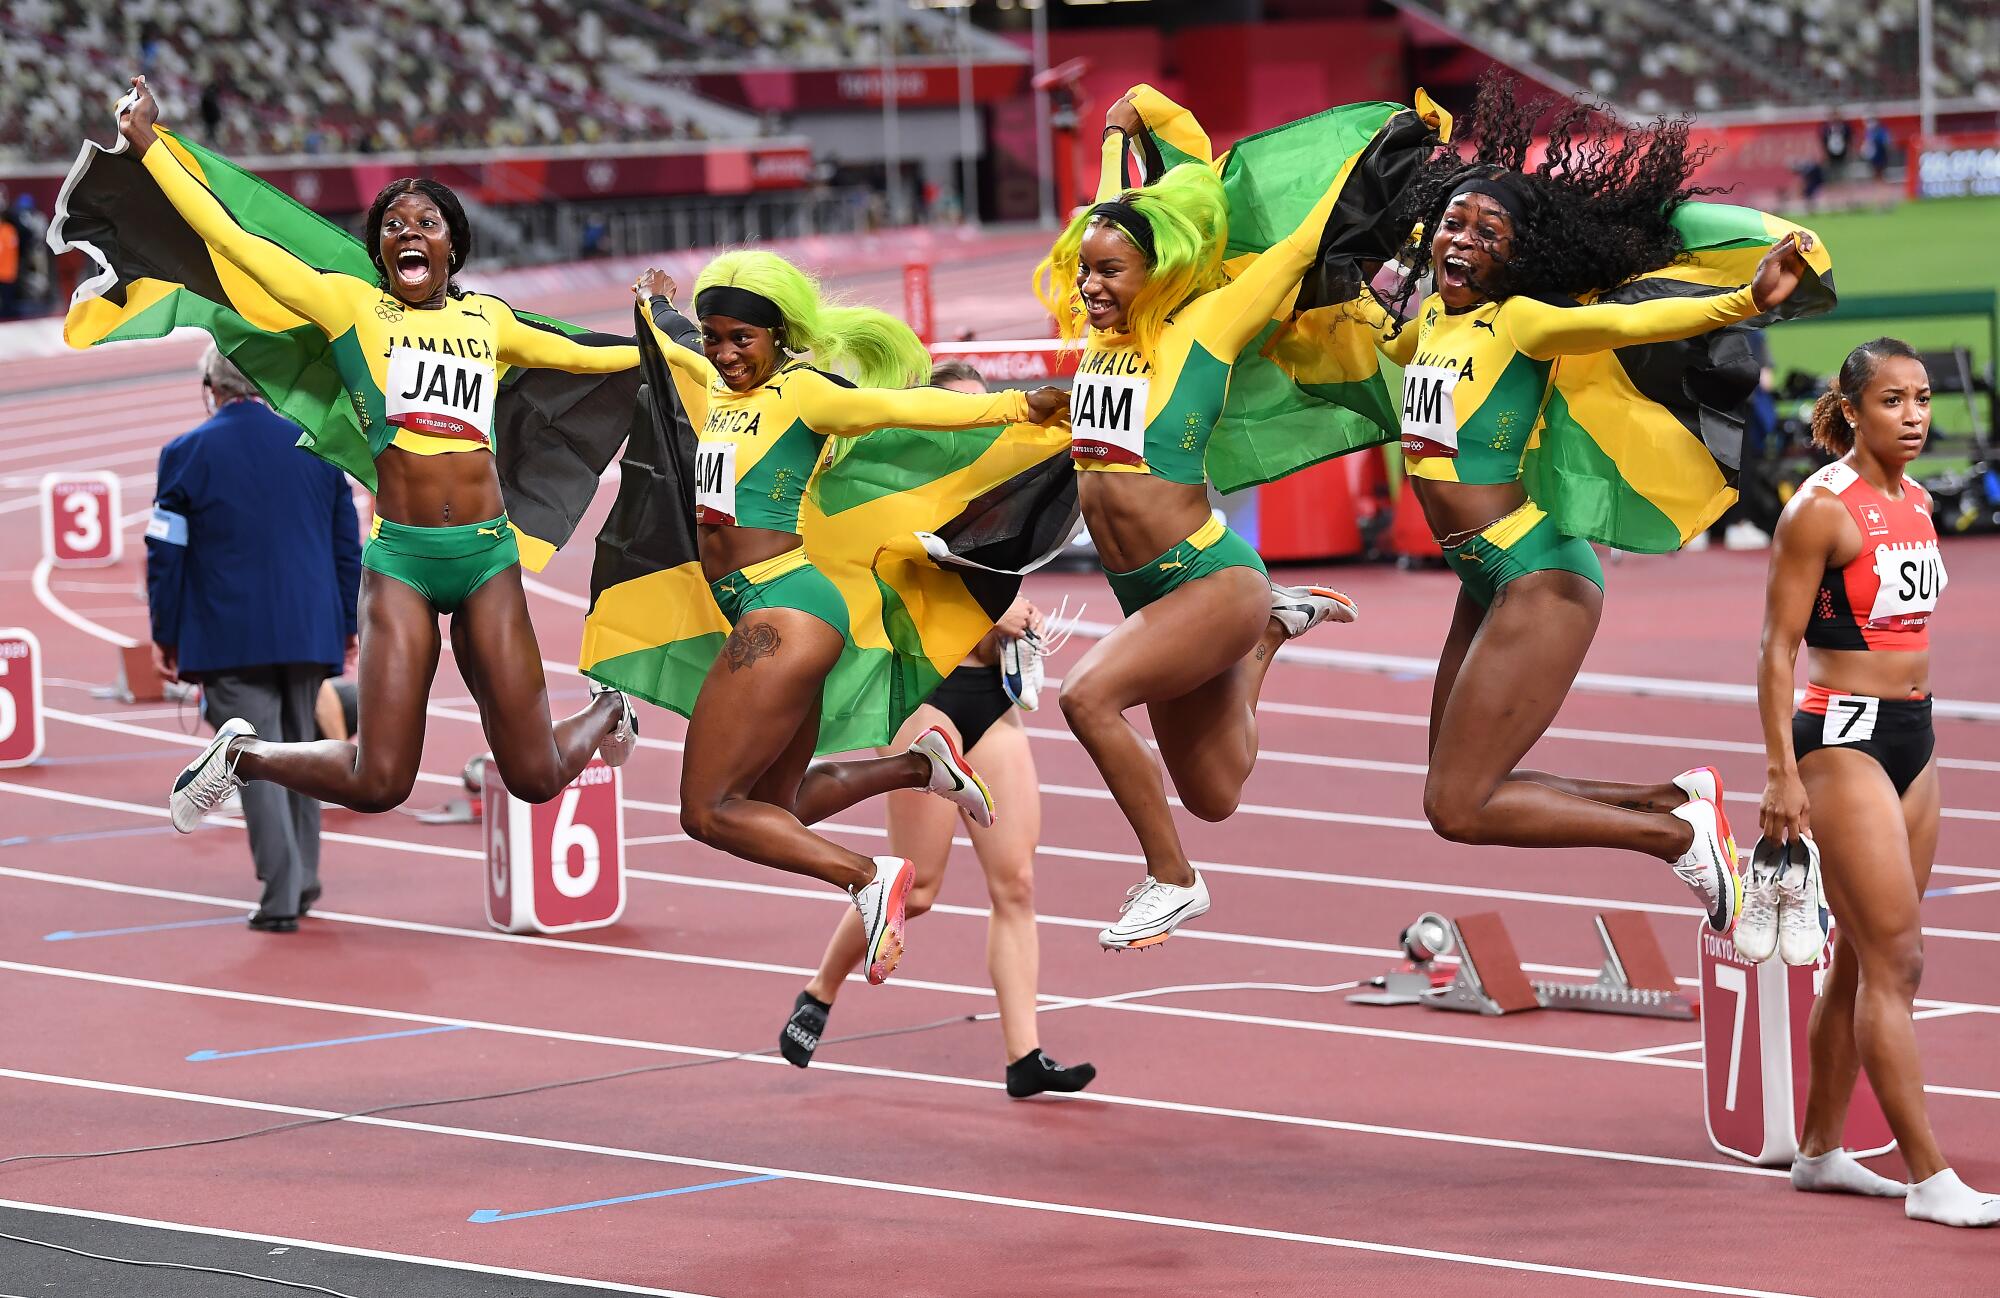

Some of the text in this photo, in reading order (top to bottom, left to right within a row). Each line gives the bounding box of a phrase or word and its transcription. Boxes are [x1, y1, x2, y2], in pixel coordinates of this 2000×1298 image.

[384, 336, 494, 361] JAMAICA
[401, 361, 482, 413] JAM
[1072, 384, 1134, 432] JAM
[703, 405, 761, 436] MAICA
[63, 491, 102, 552] 3
[1898, 559, 1939, 601] SUI
[1838, 700, 1867, 738] 7
[491, 791, 508, 898] 6
[551, 788, 600, 898] 6
[1703, 934, 1734, 961] TOKYO
[1715, 963, 1747, 1112] 7
